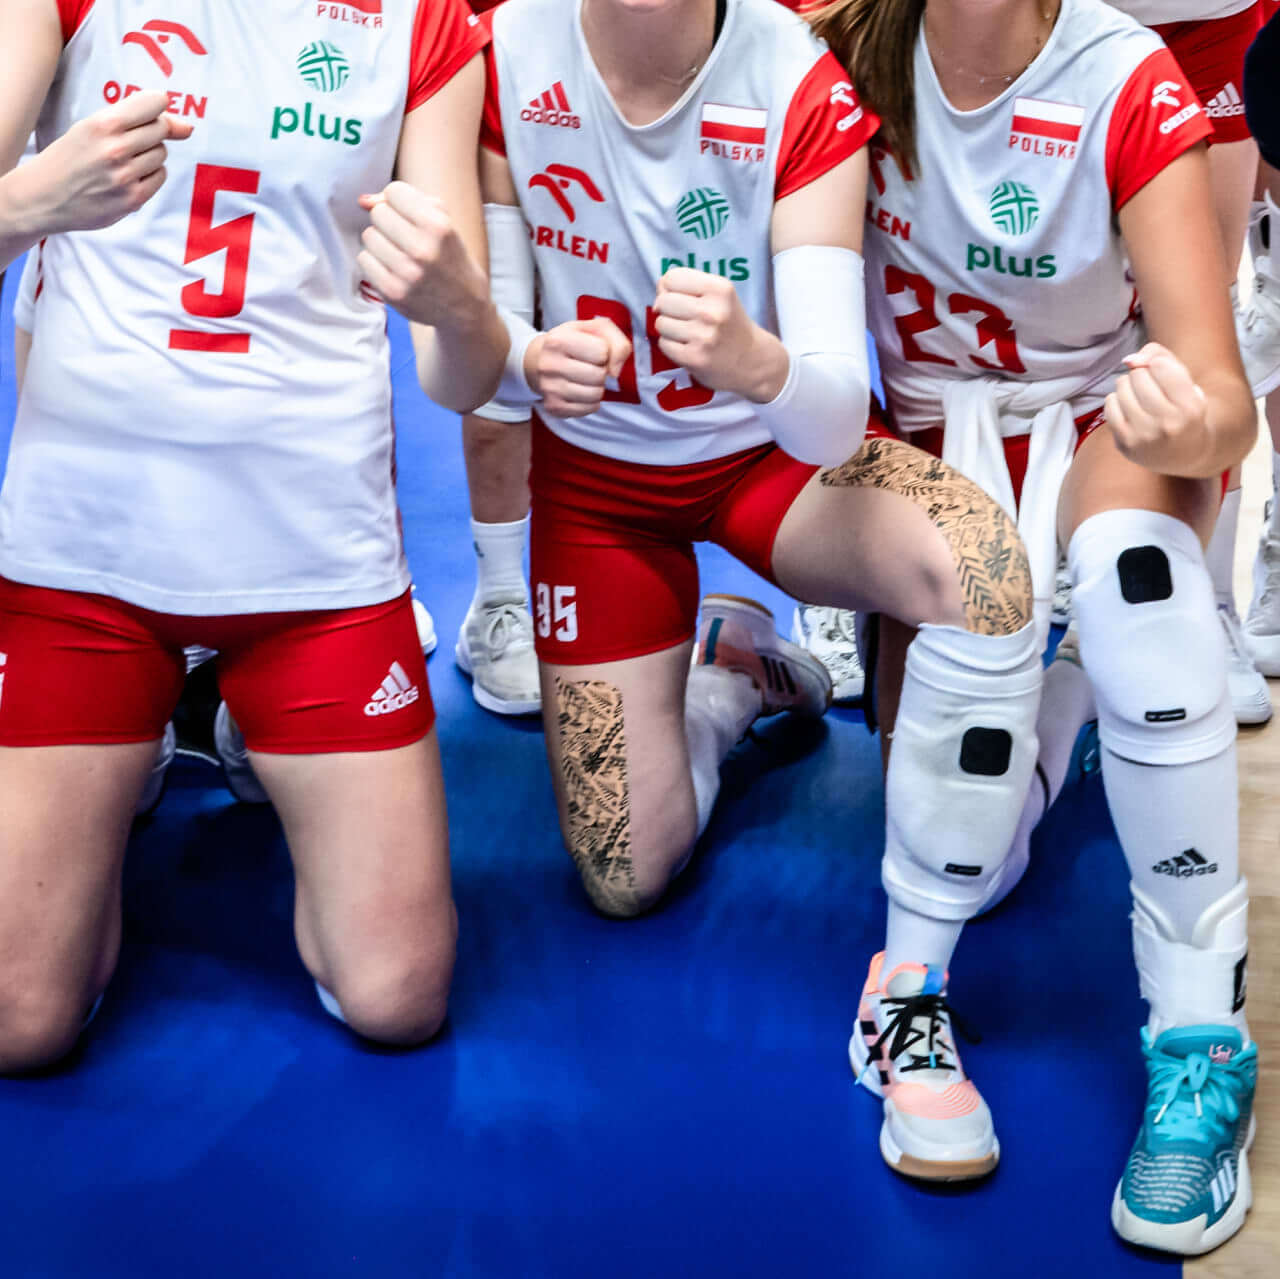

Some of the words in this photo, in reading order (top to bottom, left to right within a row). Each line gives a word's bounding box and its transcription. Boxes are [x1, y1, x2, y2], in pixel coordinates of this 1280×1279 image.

[316, 3, 384, 29] POLSKA
[102, 79, 209, 120] OEN
[269, 101, 363, 146] plus
[519, 106, 582, 130] adidas
[699, 138, 767, 164] POLSKA
[180, 162, 262, 320] 5
[966, 241, 1058, 279] plus
[364, 685, 421, 718] adidas
[1151, 859, 1218, 879] adidas
